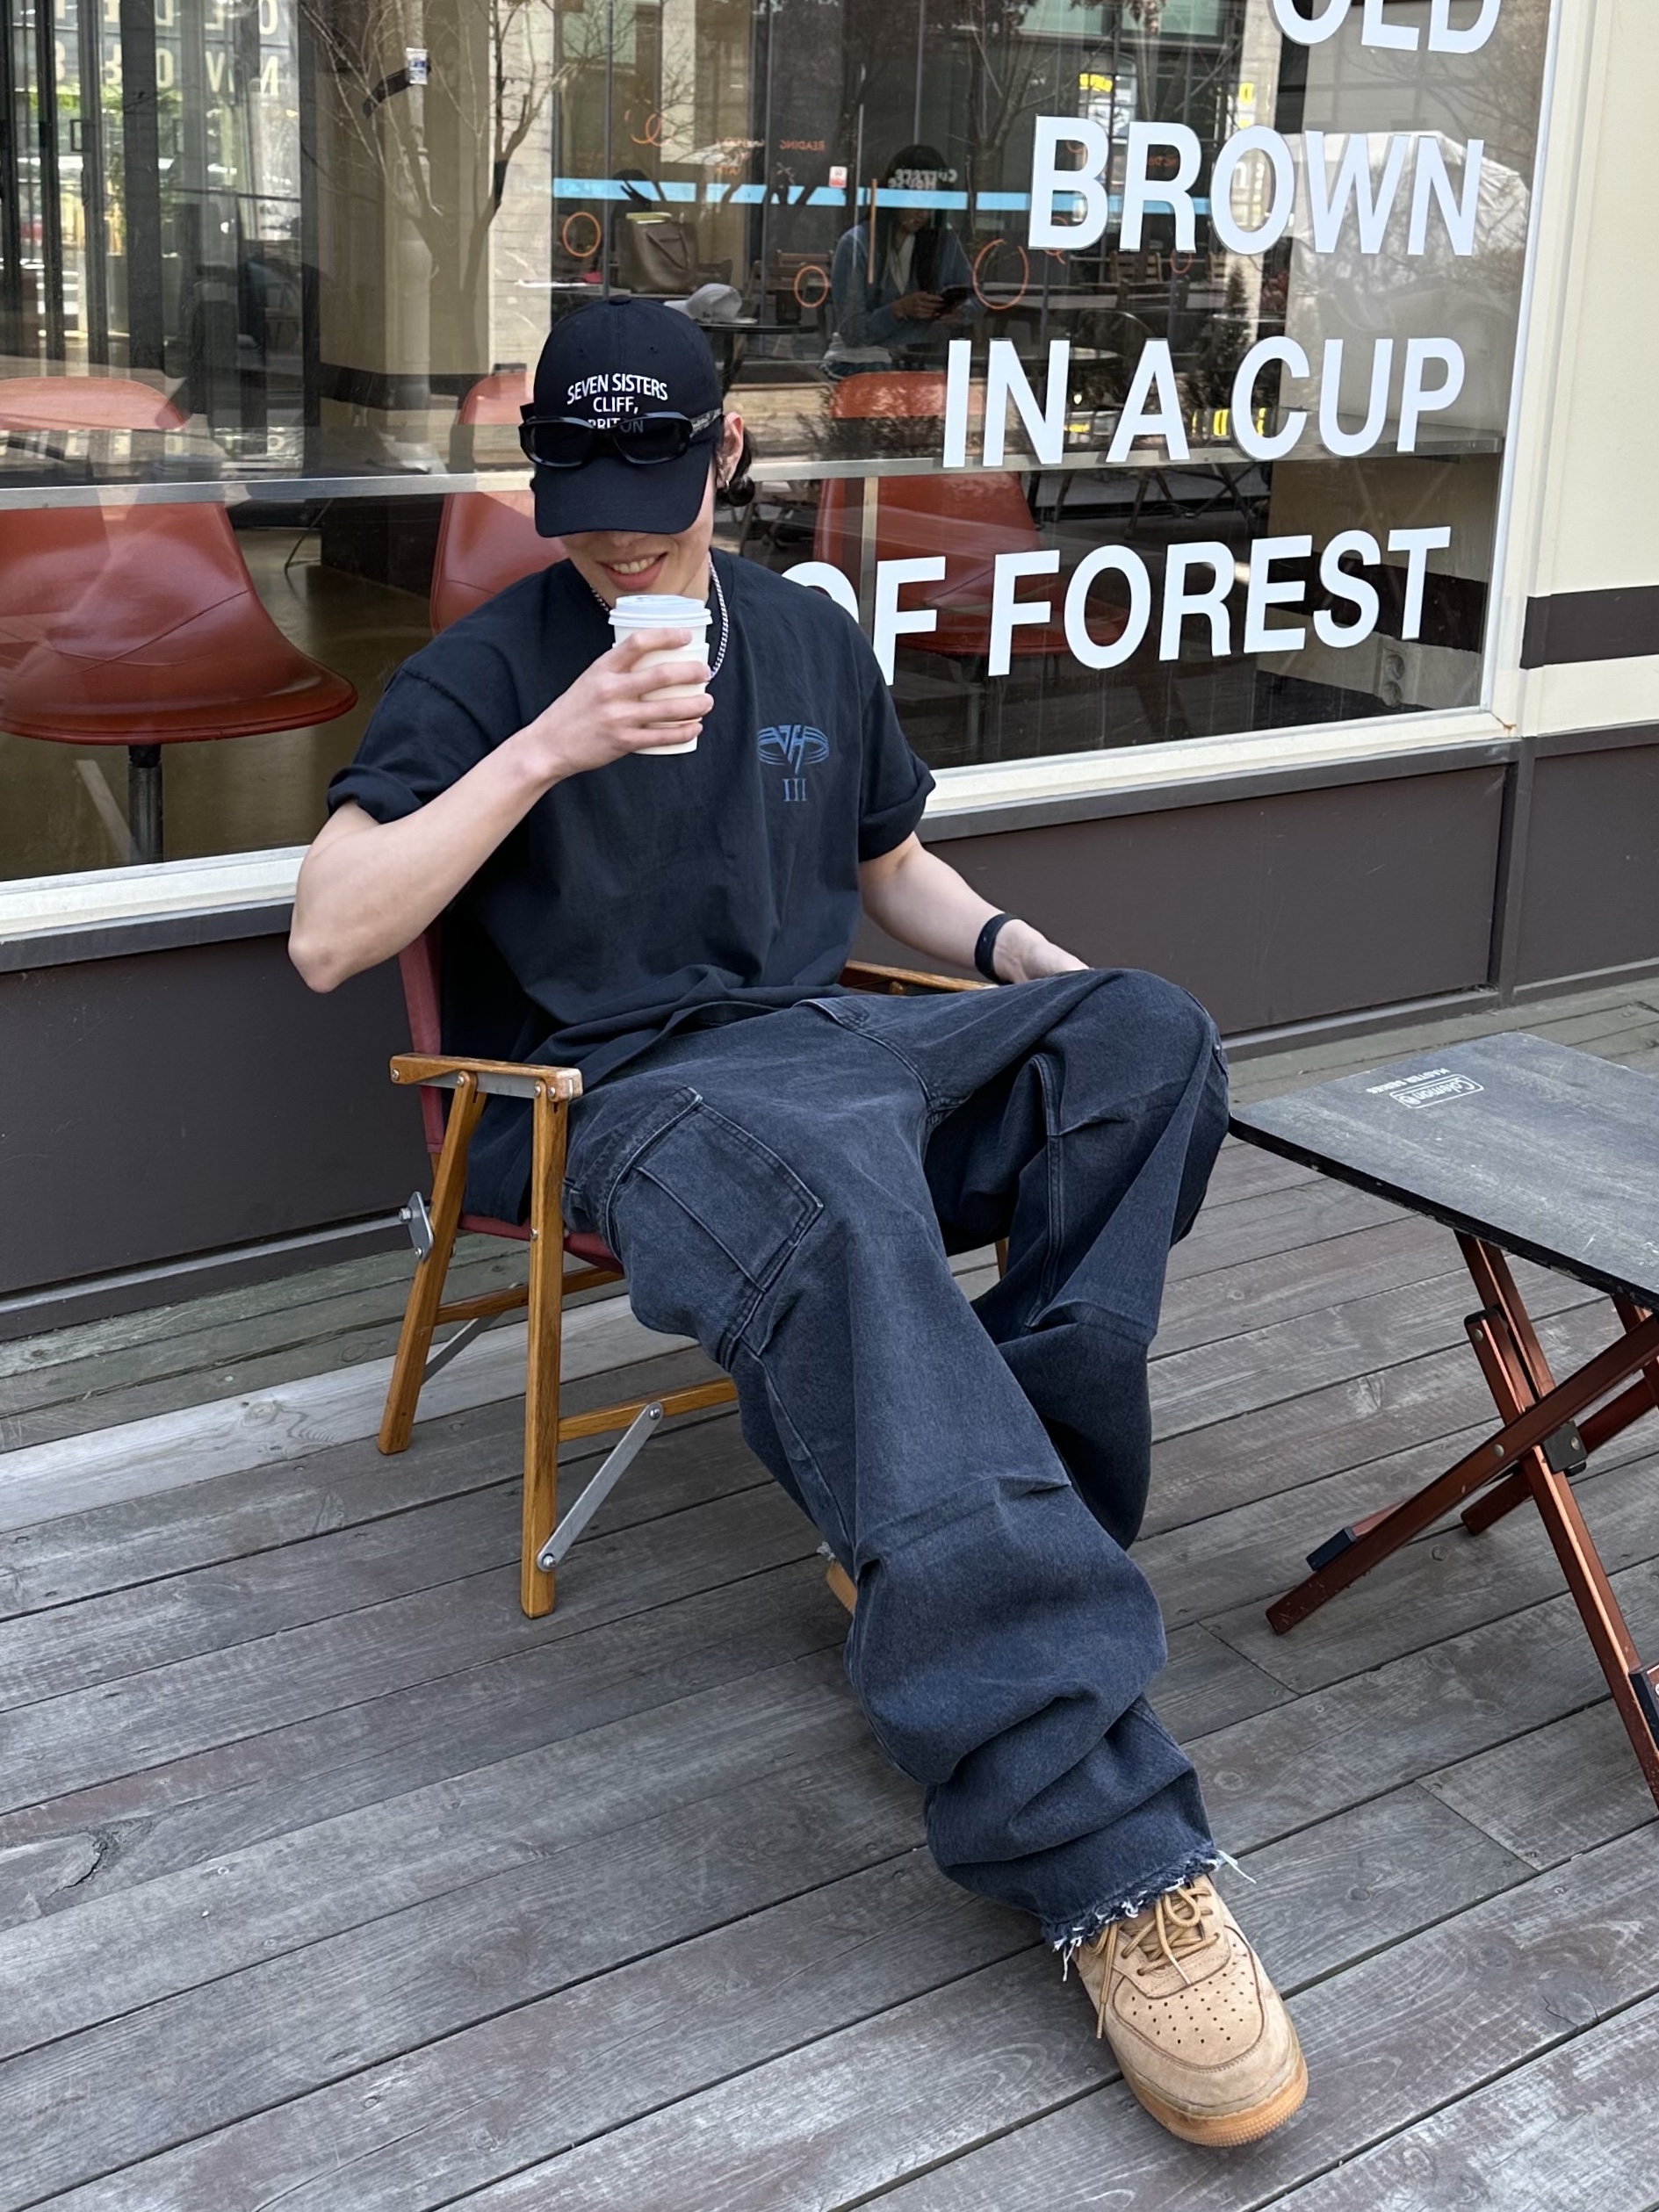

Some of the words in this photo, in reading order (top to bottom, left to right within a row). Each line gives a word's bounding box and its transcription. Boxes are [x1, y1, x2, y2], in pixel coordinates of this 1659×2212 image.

[1029, 112, 1486, 256] BROWN
[566, 371, 610, 406] SEVEN
[611, 371, 669, 402] SISTERS
[592, 396, 639, 415] CLIFF,
[943, 340, 1070, 468] IN
[1106, 340, 1190, 463] A
[1231, 335, 1465, 460] CUP
[988, 526, 1451, 677] FOREST
[1411, 1078, 1475, 1100] Coleman
